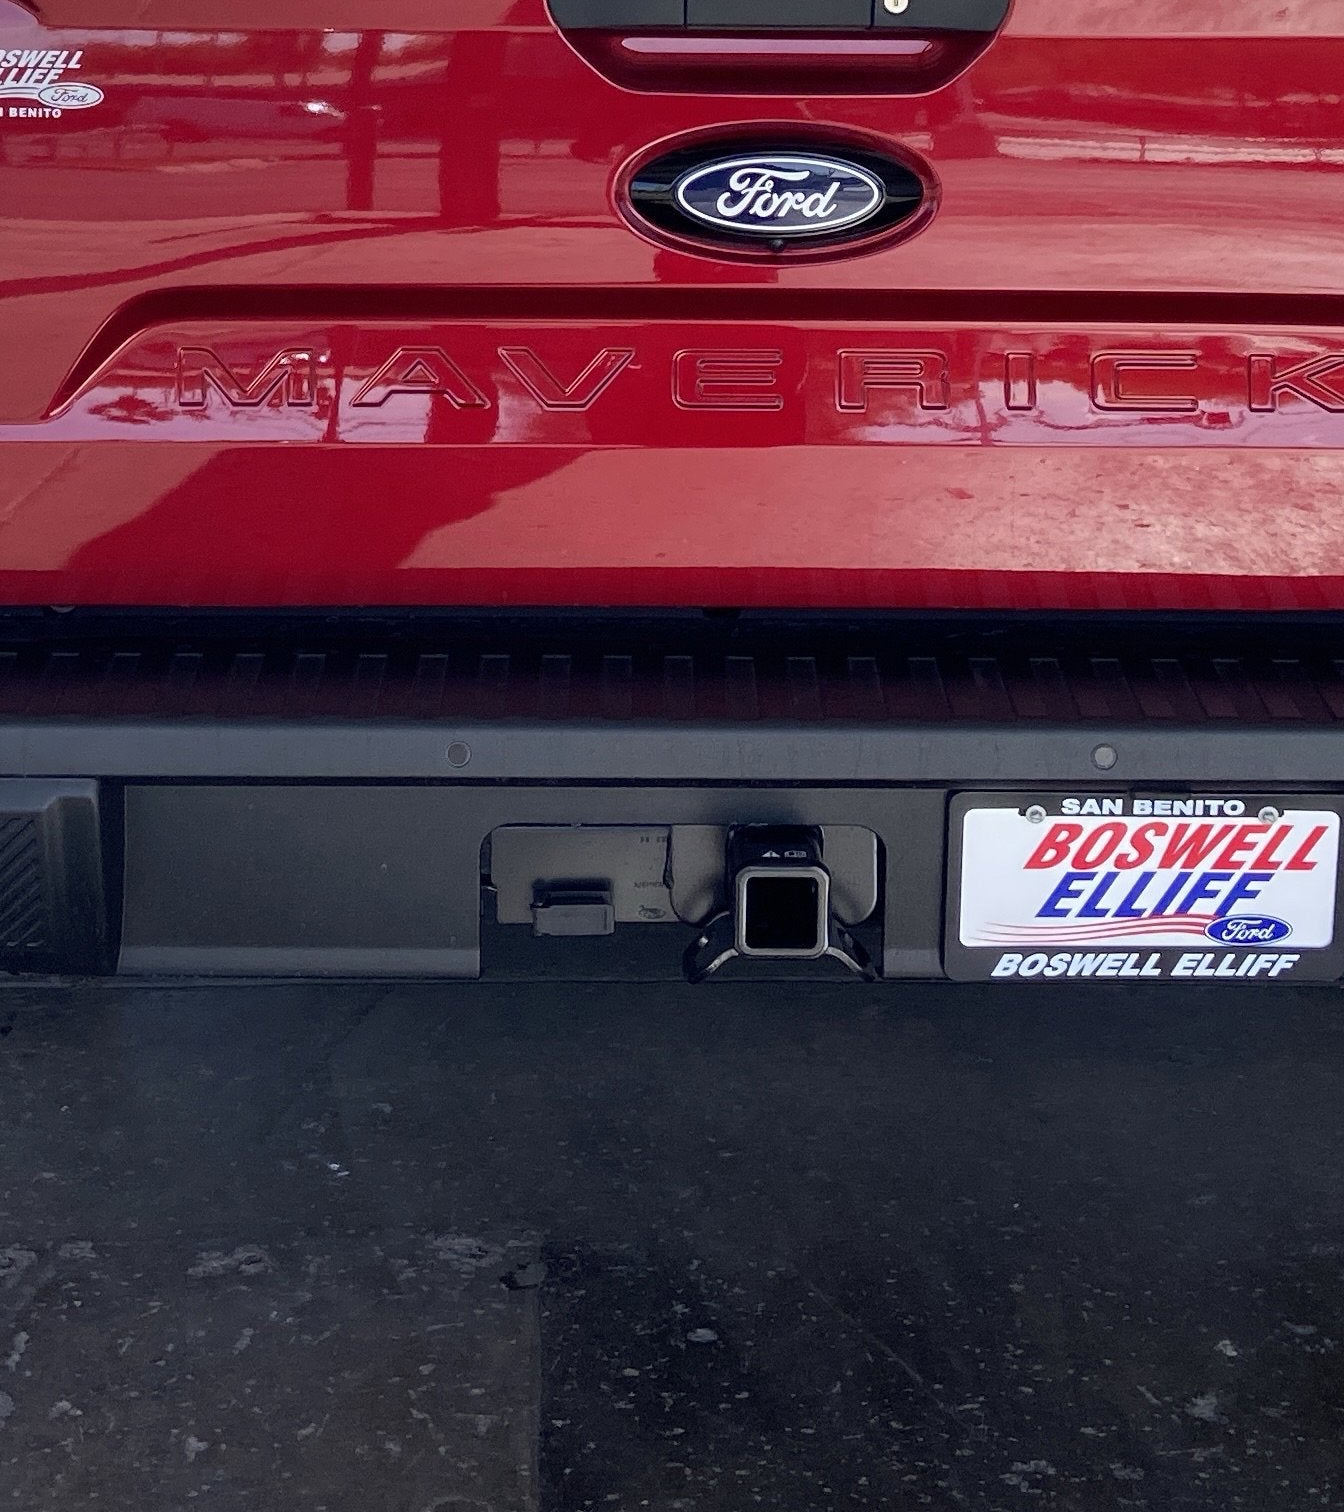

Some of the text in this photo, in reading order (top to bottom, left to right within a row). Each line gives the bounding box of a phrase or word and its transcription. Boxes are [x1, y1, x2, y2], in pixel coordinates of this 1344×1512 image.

[50, 88, 88, 103] Ford
[8, 107, 62, 118] BENITO
[716, 167, 841, 218] Ford
[1061, 798, 1246, 816] SAN BENITO
[1023, 821, 1329, 871] BOSWELL
[1035, 871, 1275, 919] ELLIFF
[1221, 918, 1276, 941] Ford
[991, 952, 1301, 978] BOSWELL ELLIFF
